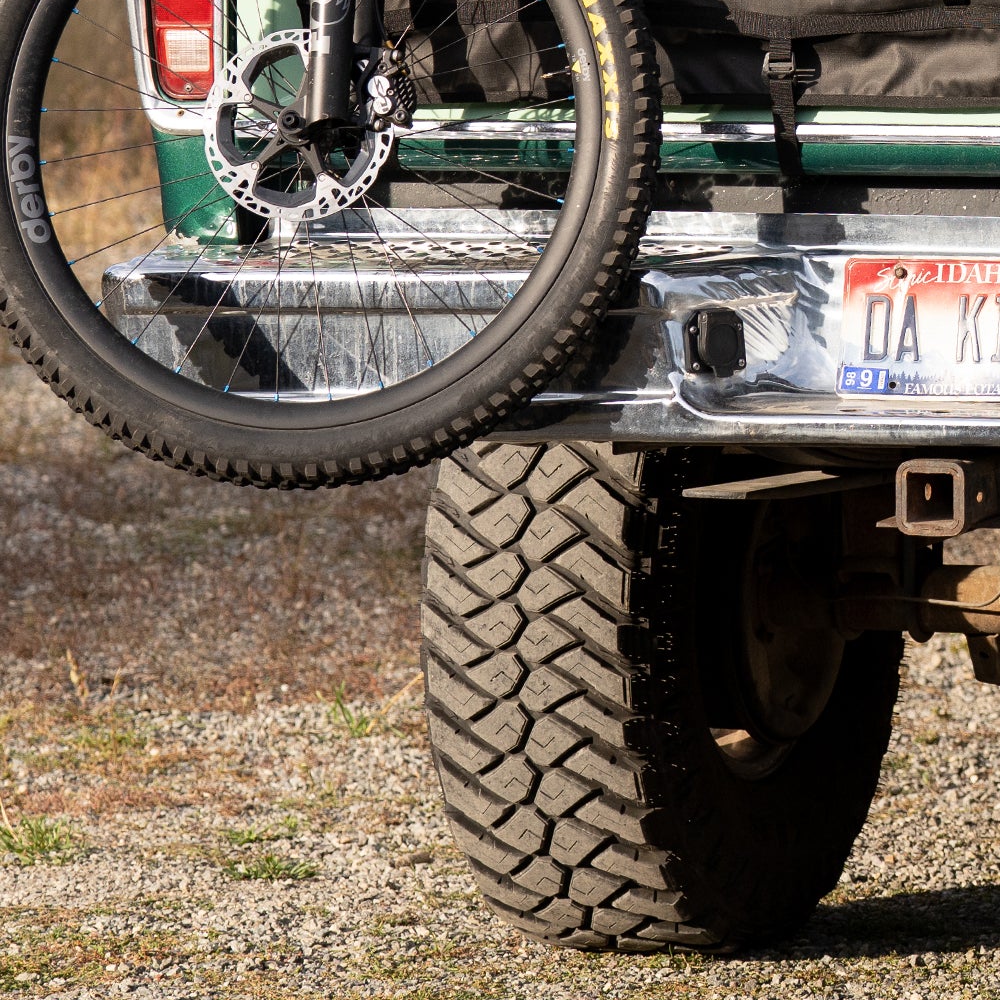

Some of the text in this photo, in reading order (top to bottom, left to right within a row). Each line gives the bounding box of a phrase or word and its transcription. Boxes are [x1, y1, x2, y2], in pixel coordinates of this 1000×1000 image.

[8, 135, 51, 244] derby
[862, 294, 920, 363] DA
[904, 383, 961, 396] FAMOUS
